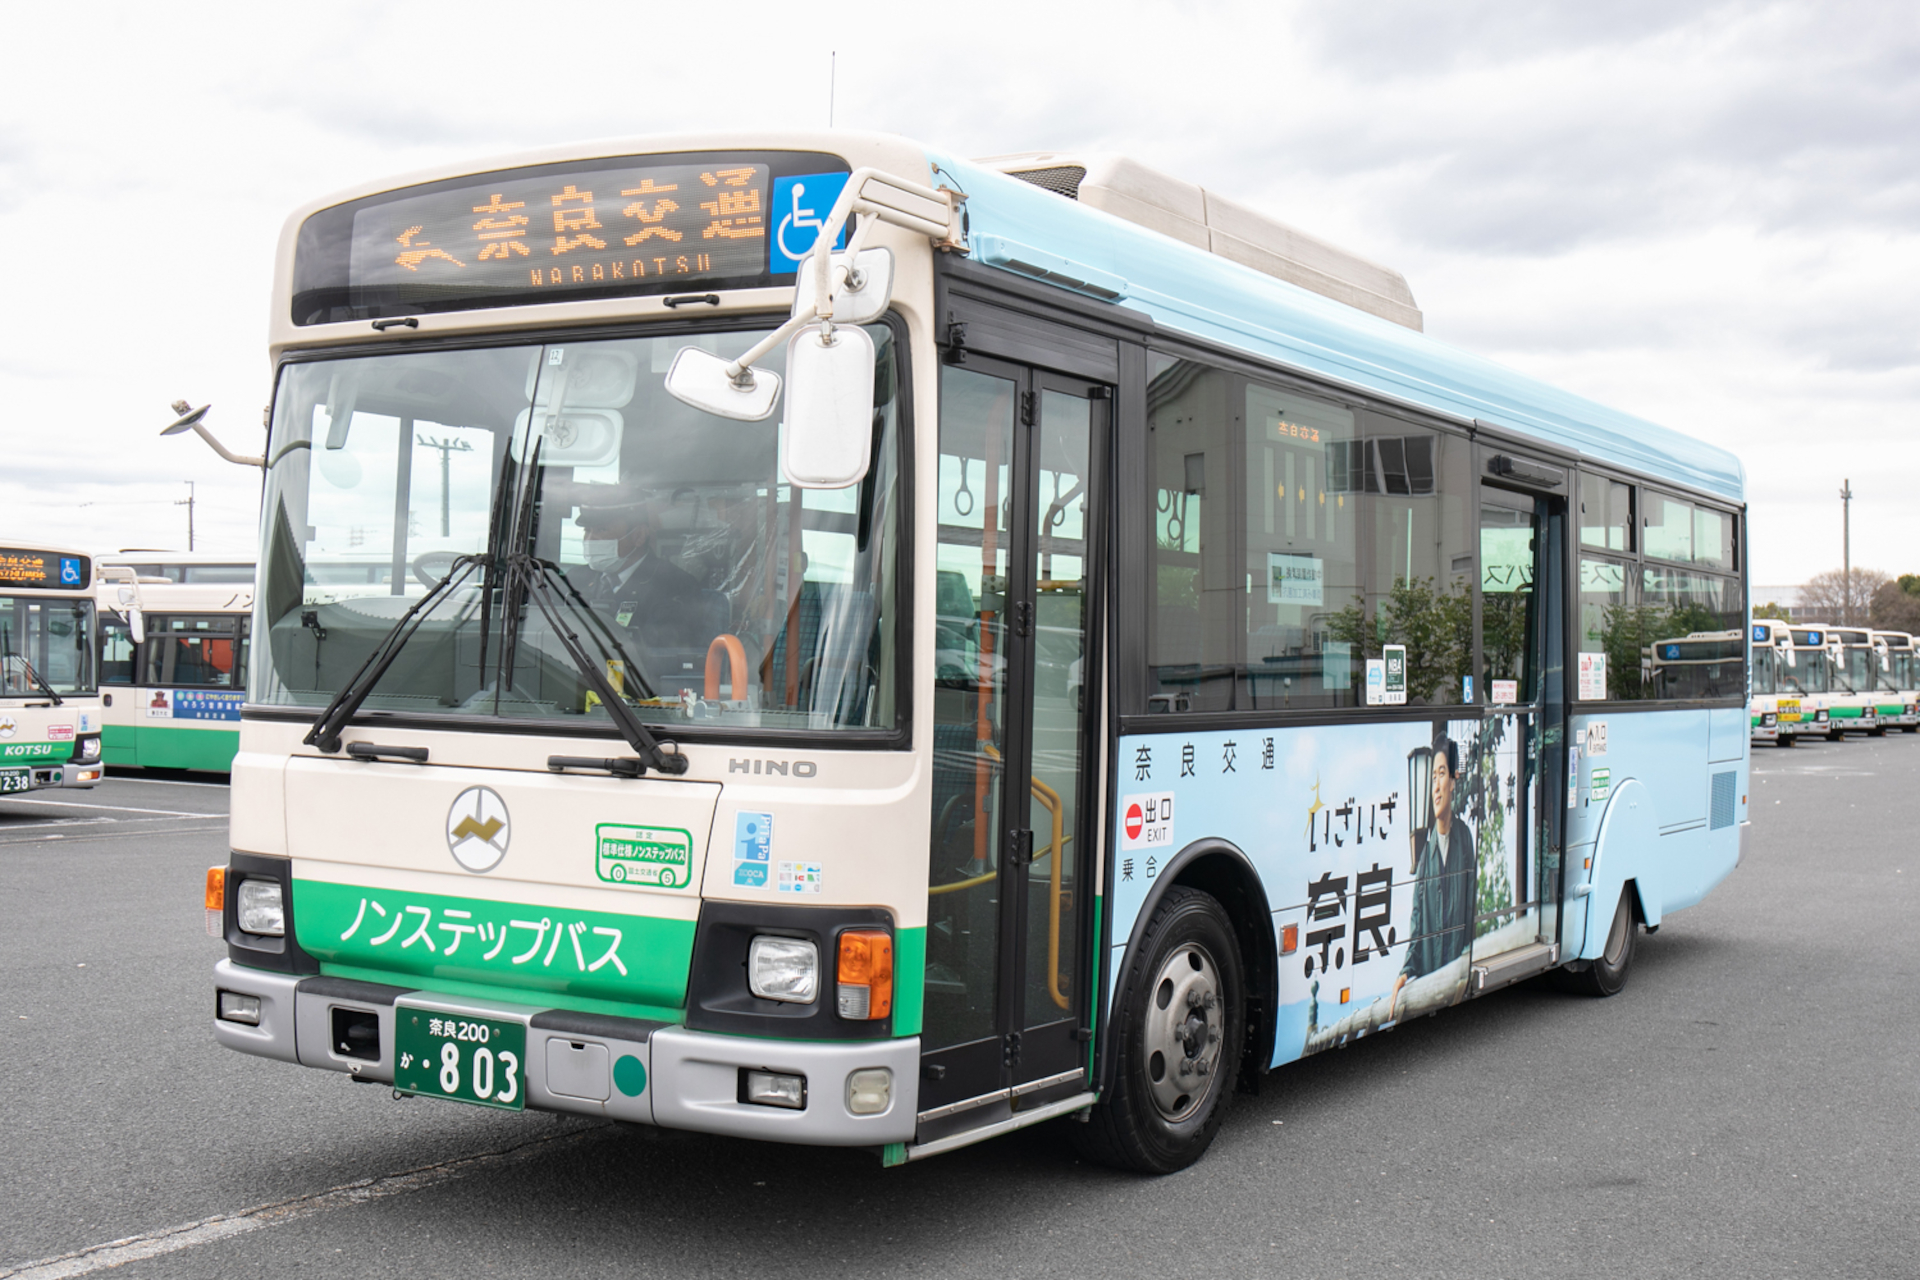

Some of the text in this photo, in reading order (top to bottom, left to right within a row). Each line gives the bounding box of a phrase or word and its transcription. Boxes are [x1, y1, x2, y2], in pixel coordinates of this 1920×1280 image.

[472, 166, 765, 260] 奈良交通
[4, 744, 52, 756] KOTSU
[729, 758, 817, 778] HINO
[1134, 737, 1275, 782] 奈良交通
[1145, 797, 1171, 824] 出口
[1310, 792, 1398, 852] いざいざ
[758, 815, 771, 860] PiTaPa
[1147, 827, 1167, 842] EXIT
[1121, 855, 1158, 882] 乗合
[340, 898, 628, 977] ノンステップバス
[1304, 862, 1396, 978] 奈良
